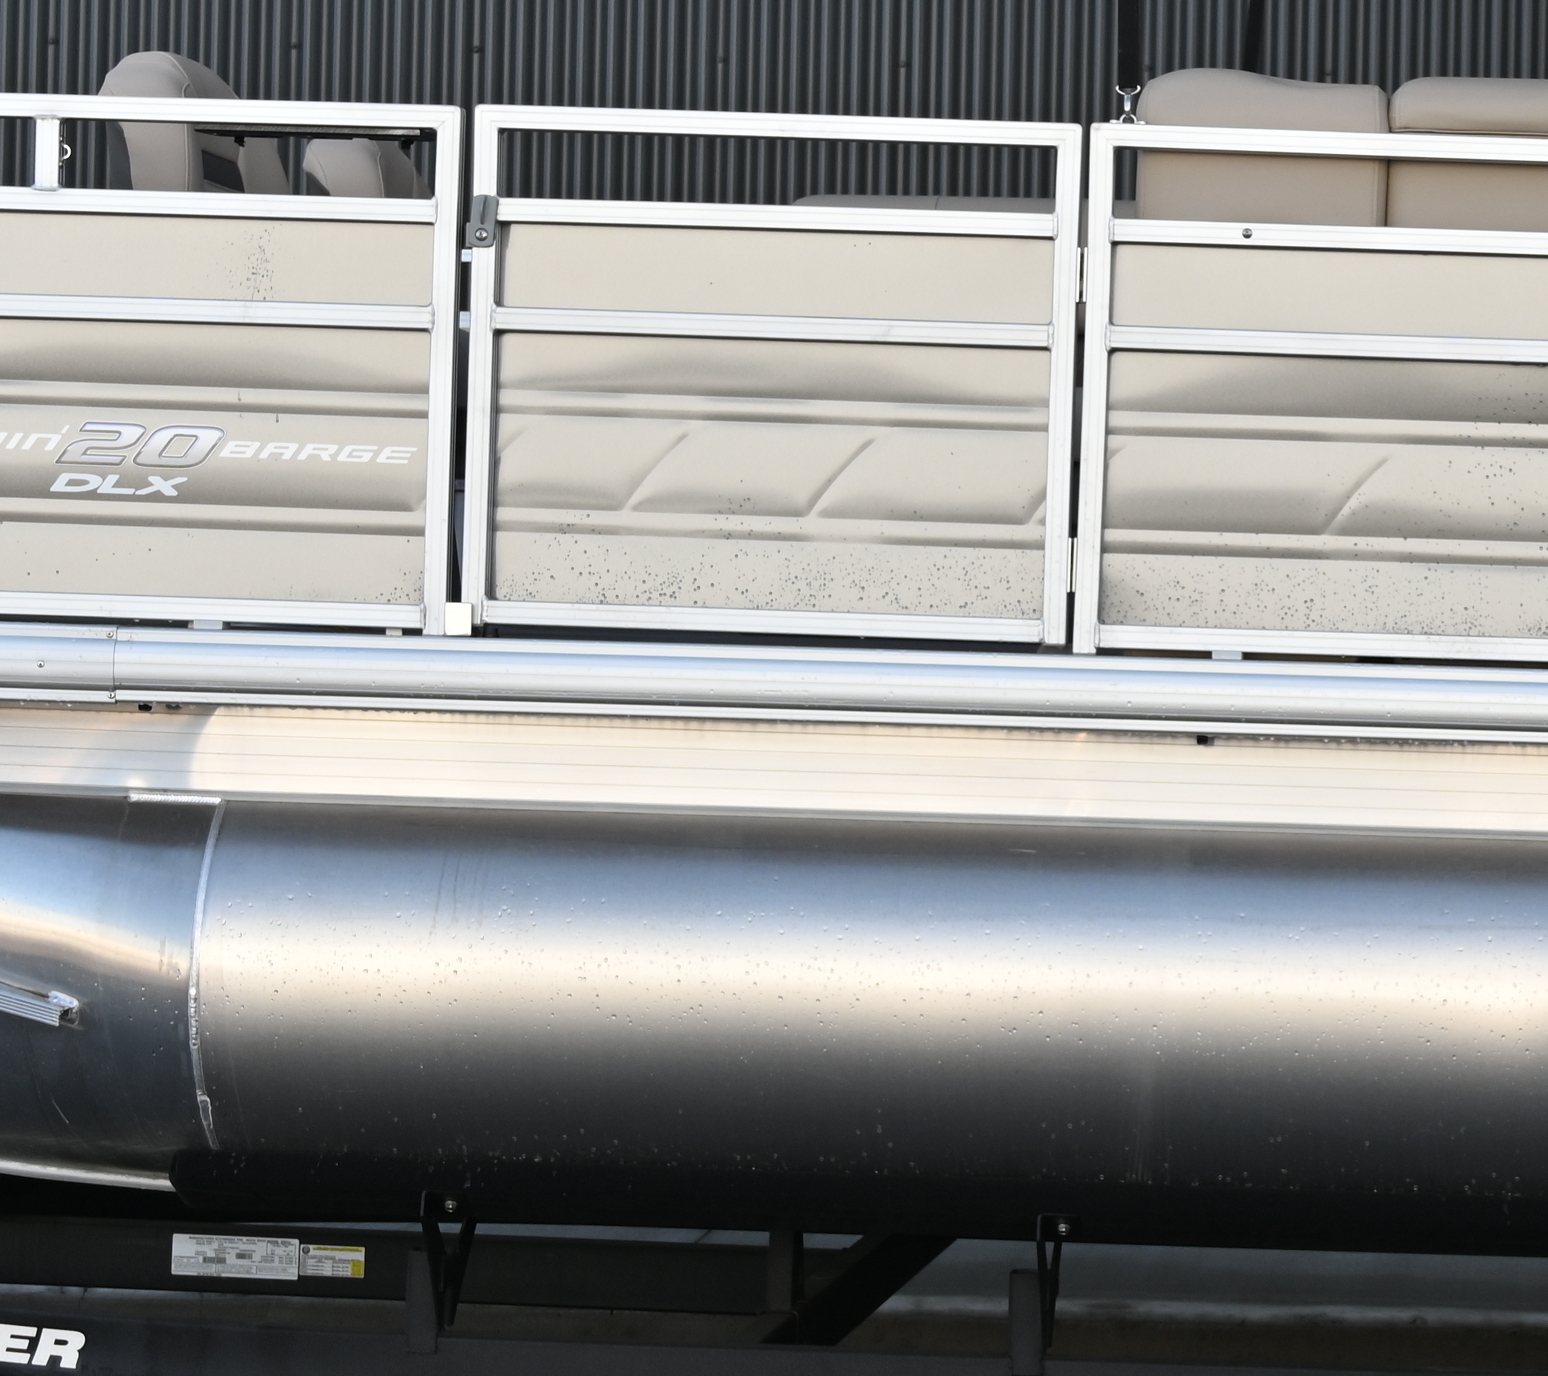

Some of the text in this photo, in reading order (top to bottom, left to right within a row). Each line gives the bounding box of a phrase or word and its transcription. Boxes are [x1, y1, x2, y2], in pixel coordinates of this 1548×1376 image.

[54, 420, 228, 470] 20
[219, 439, 419, 466] BARGE
[49, 472, 188, 497] DLX
